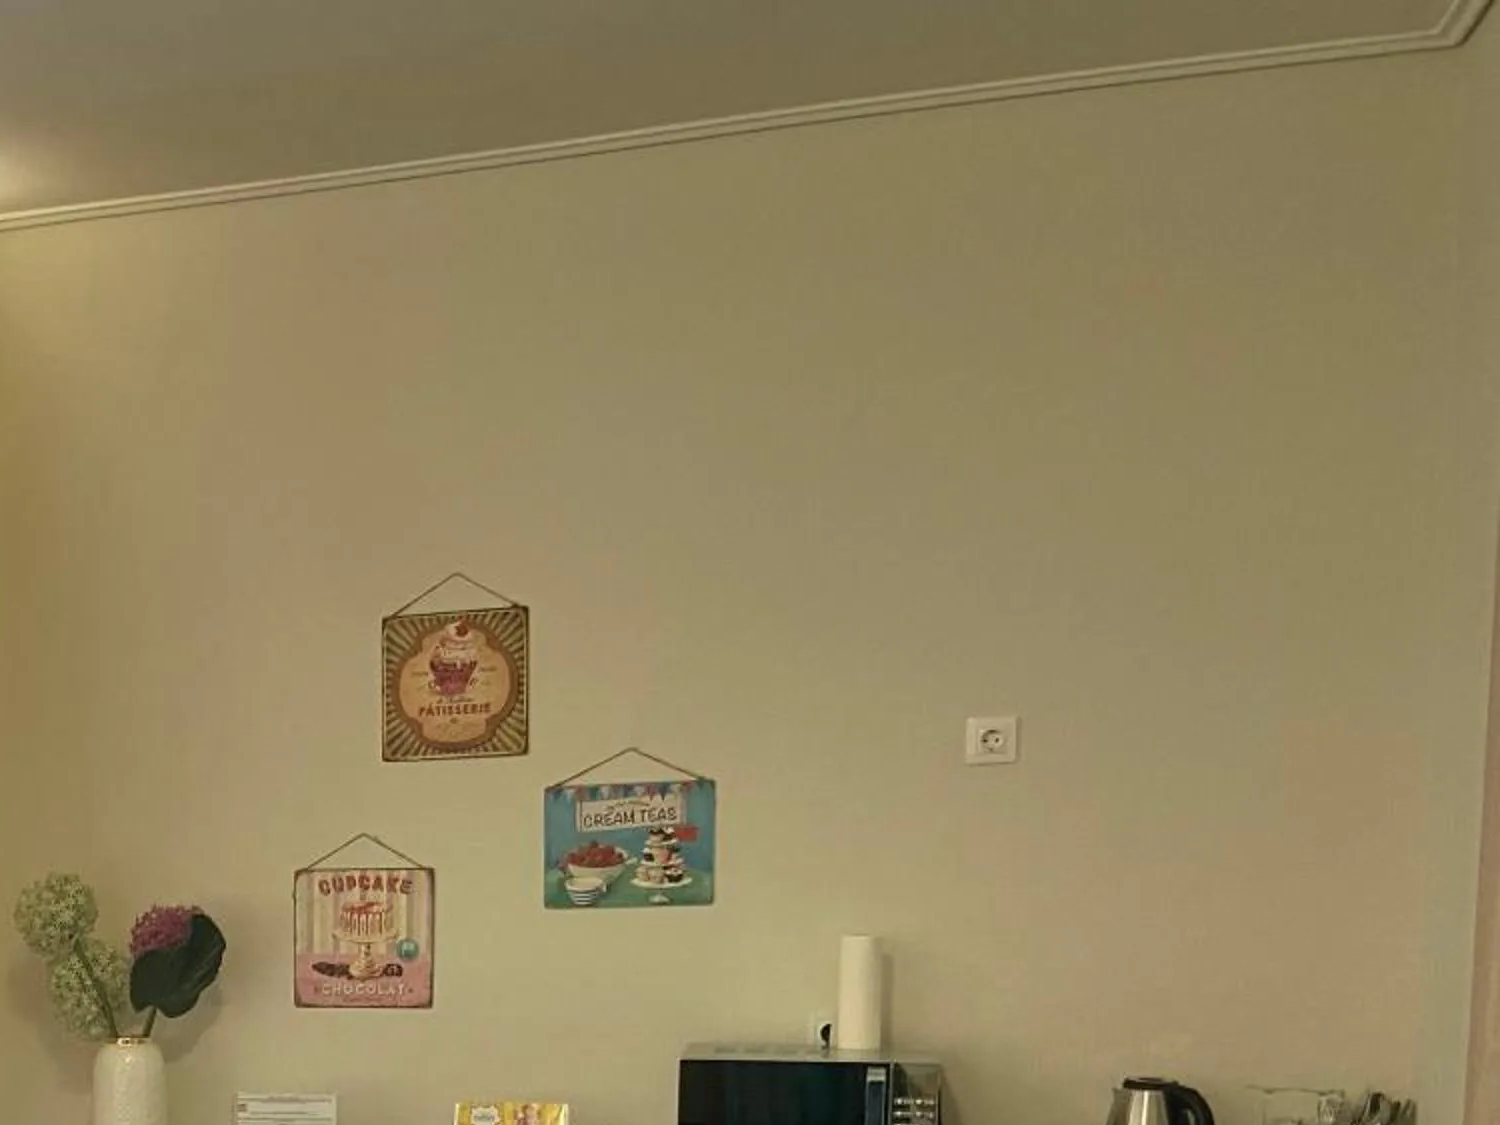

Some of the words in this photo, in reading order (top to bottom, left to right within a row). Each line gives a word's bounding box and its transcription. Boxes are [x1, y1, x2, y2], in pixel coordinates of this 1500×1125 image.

[583, 811, 635, 828] CREAM
[640, 807, 677, 823] TEAS
[318, 875, 414, 896] CUPCAKE
